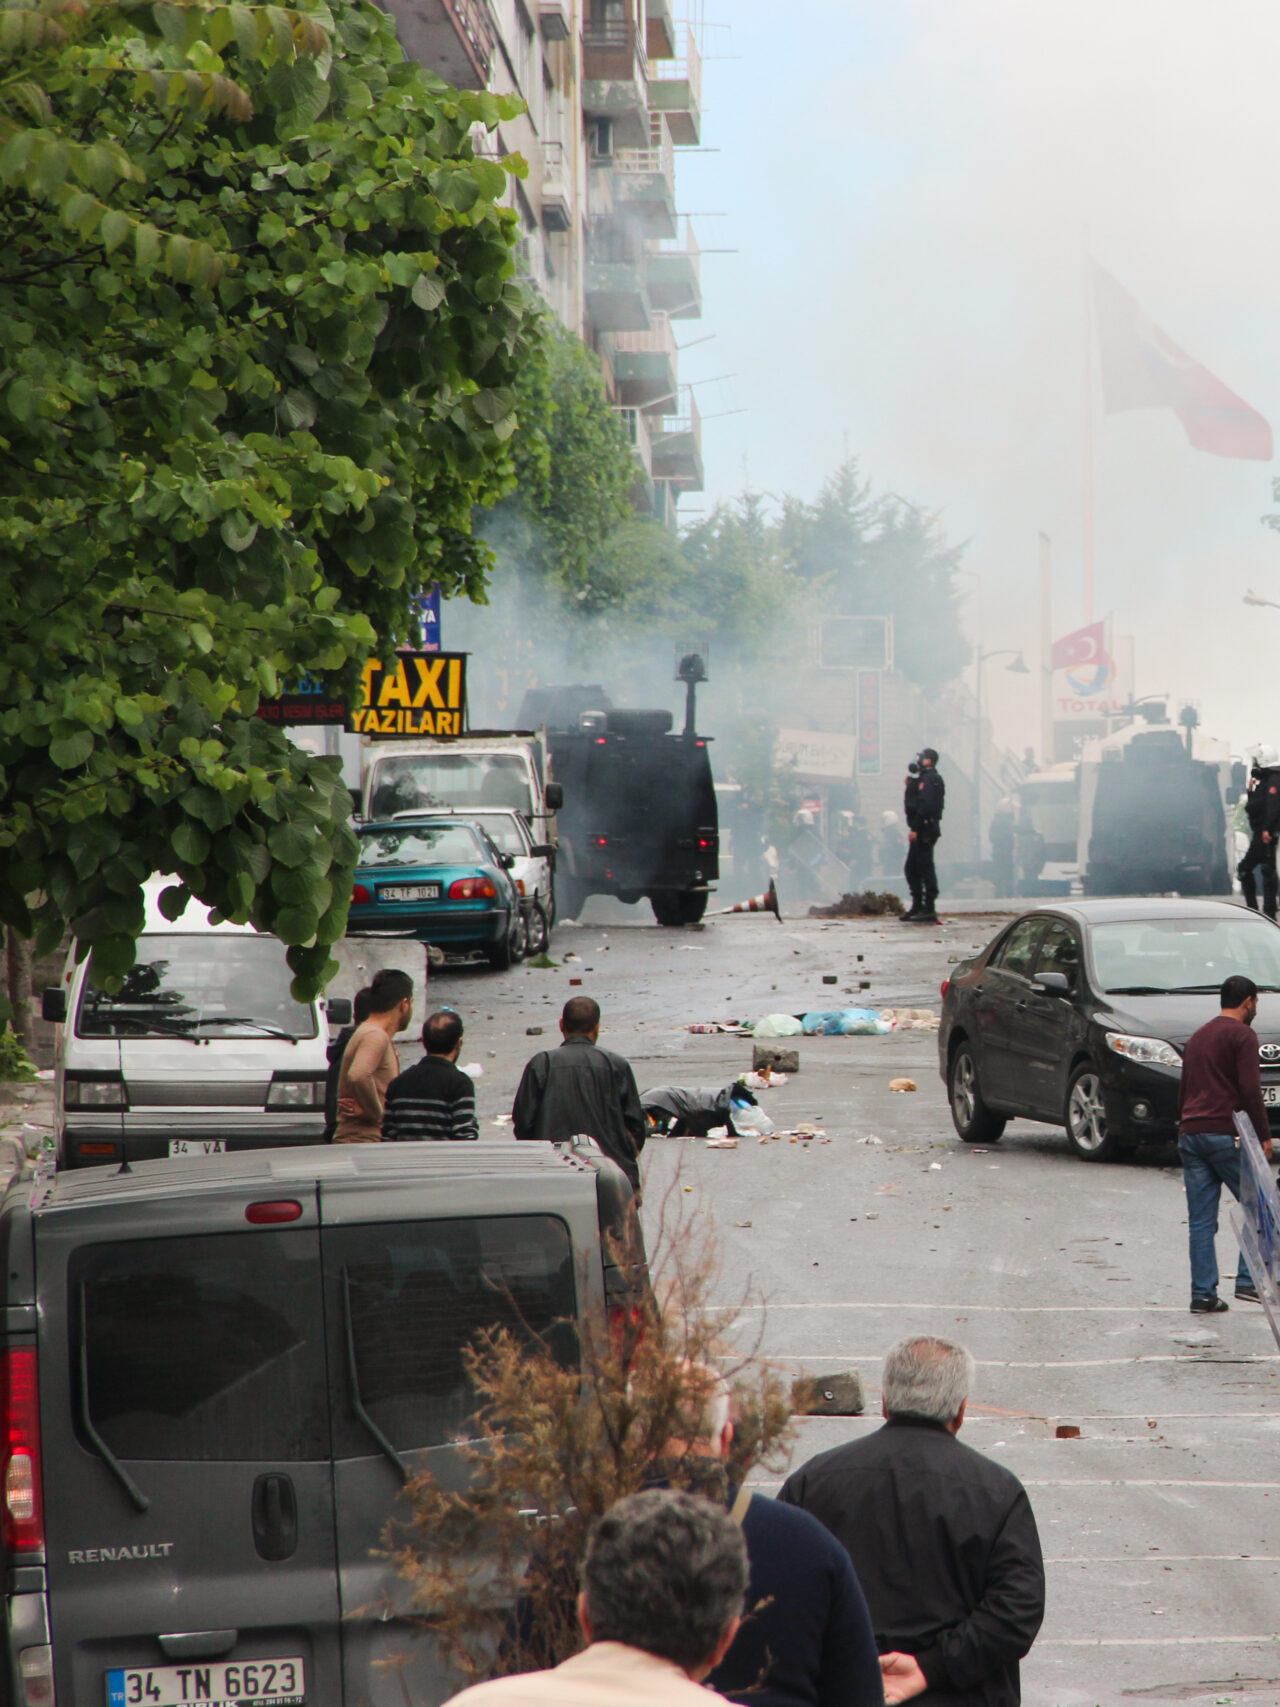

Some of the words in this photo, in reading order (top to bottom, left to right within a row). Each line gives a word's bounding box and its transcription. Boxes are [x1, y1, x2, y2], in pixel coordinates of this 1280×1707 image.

[360, 657, 461, 709] TAXI
[1056, 698, 1124, 712] TOTAL
[351, 708, 461, 736] YAZILARI
[172, 1140, 188, 1155] 34
[67, 1542, 175, 1565] RENAULT
[126, 1671, 161, 1704] 34
[176, 1667, 212, 1700] TN
[224, 1662, 297, 1697] 6623
